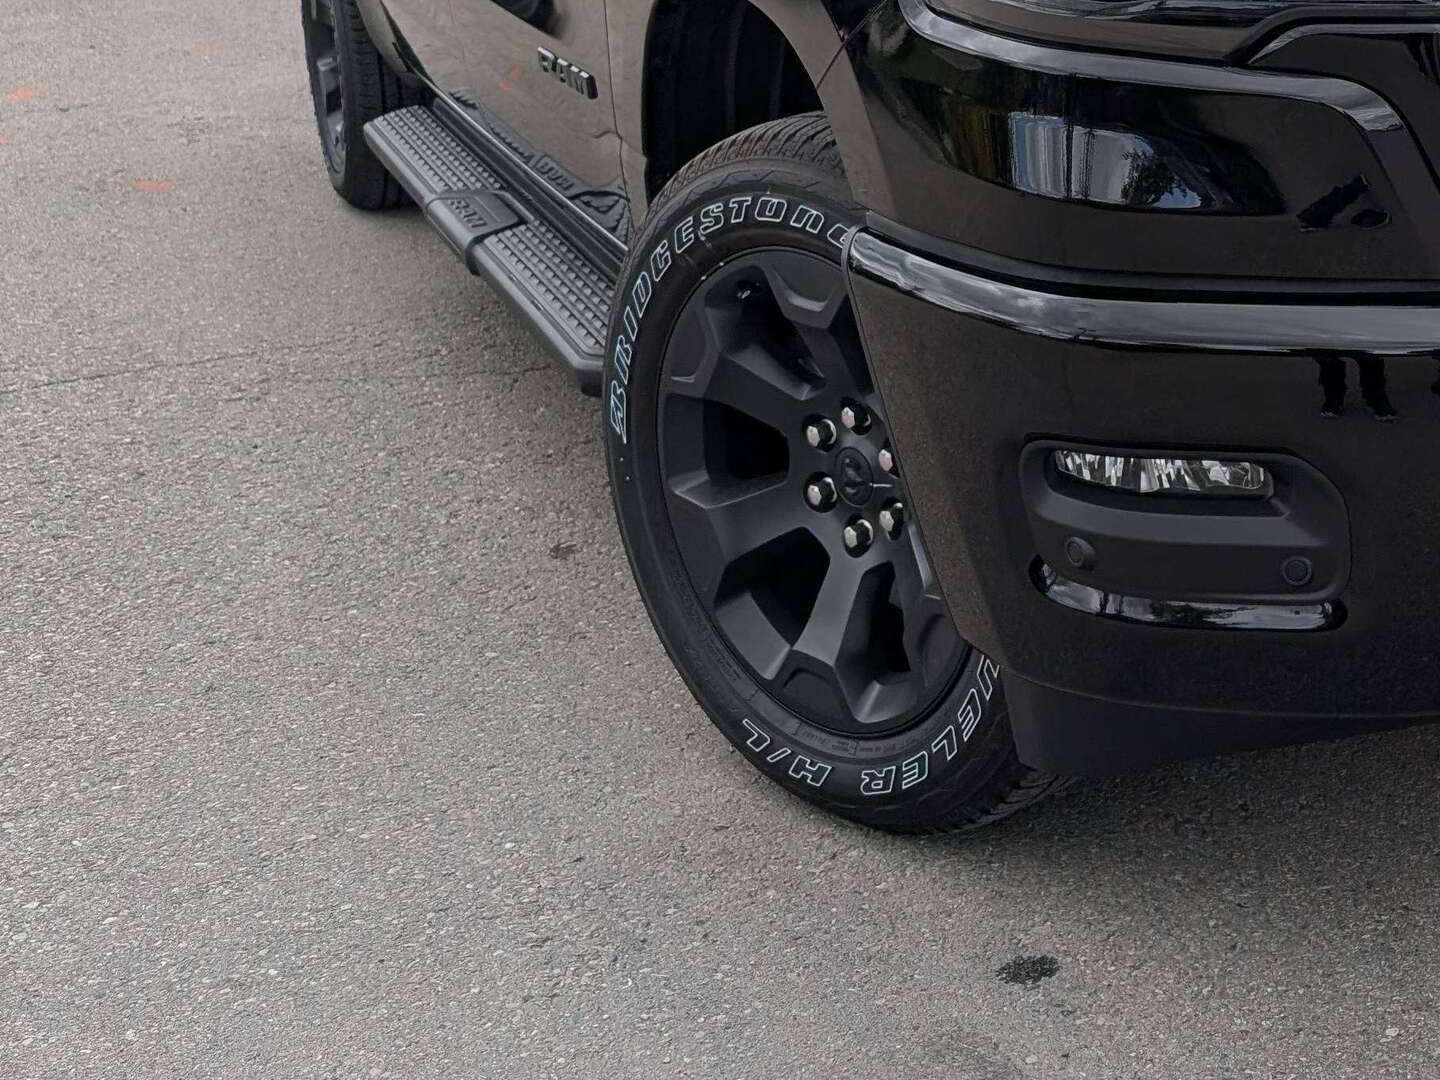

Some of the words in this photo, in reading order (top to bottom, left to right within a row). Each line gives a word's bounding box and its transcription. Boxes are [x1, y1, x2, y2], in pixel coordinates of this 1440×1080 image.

[537, 46, 598, 99] RAM
[742, 718, 832, 787] H/L
[860, 655, 1000, 796] UELER
